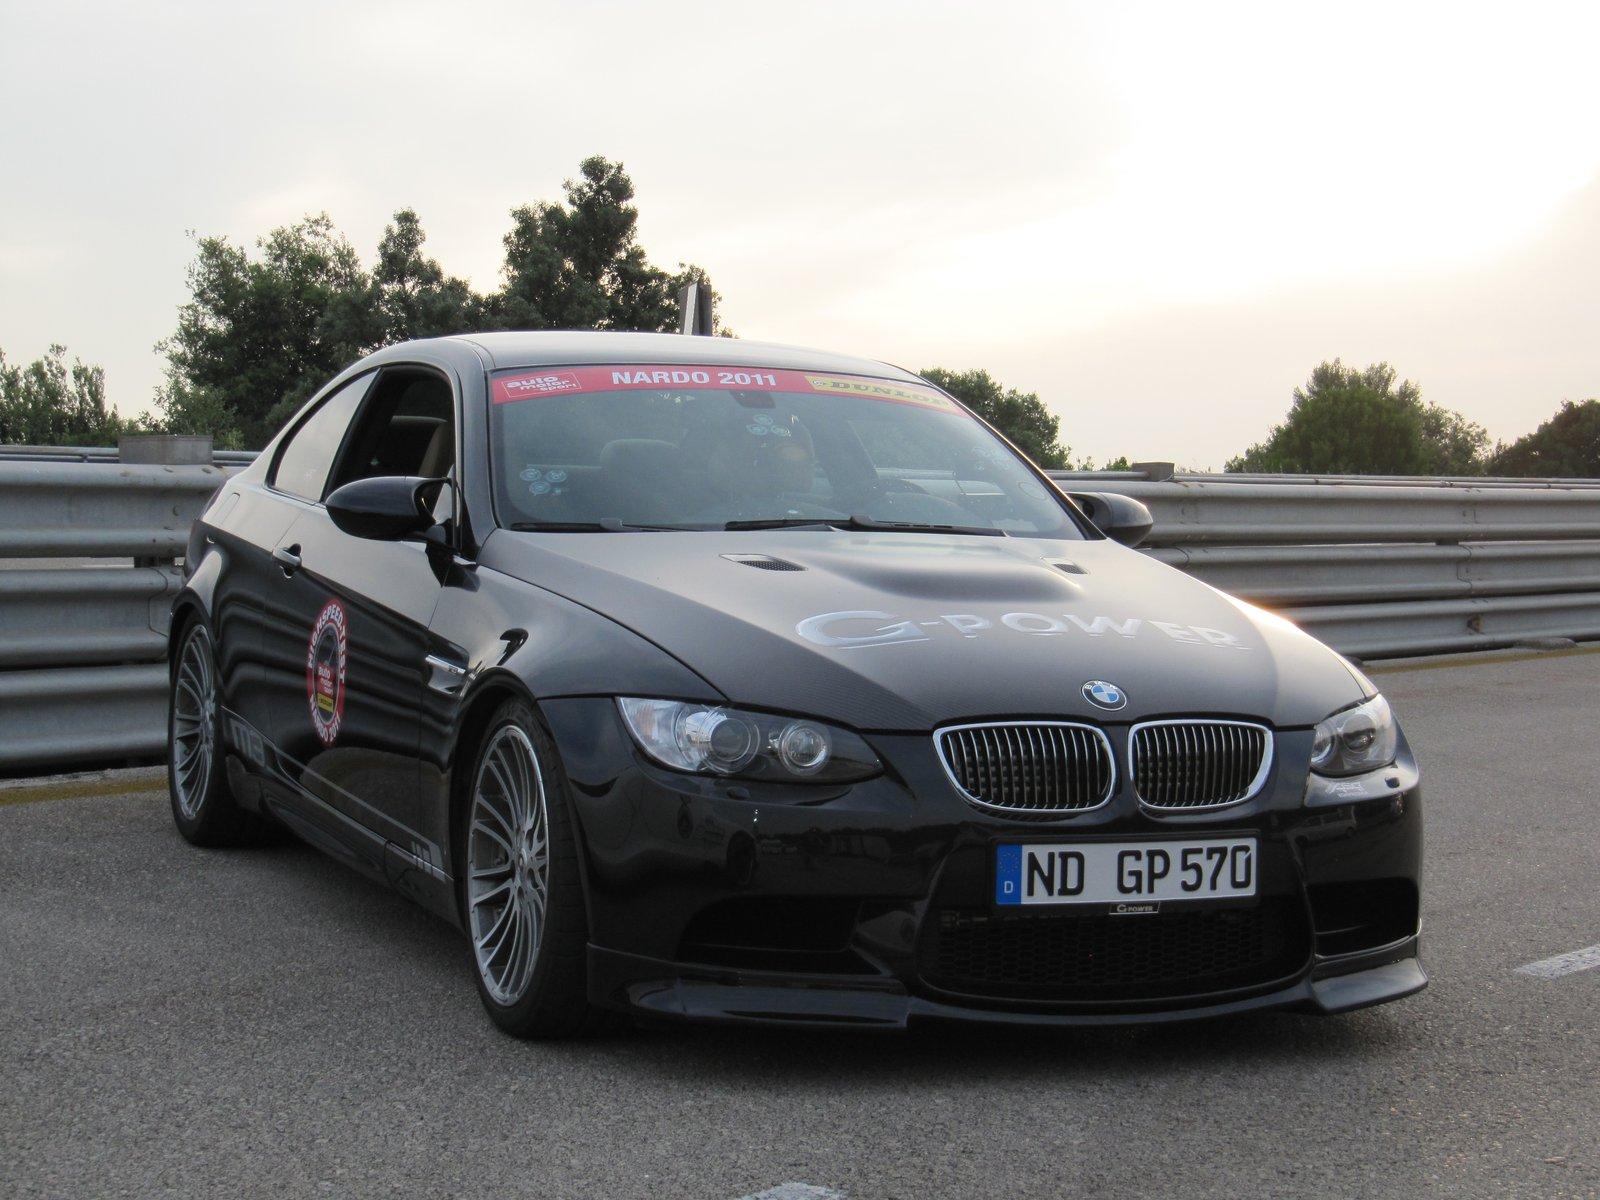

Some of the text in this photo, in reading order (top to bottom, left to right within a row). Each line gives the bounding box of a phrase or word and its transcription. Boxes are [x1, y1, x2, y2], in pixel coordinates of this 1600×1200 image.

[506, 376, 560, 388] auto
[520, 379, 570, 390] motor
[612, 371, 776, 386] NARDO 2011
[796, 610, 1251, 650] G-POWER
[1027, 845, 1251, 897] ND GP 570
[1003, 881, 1013, 893] D
